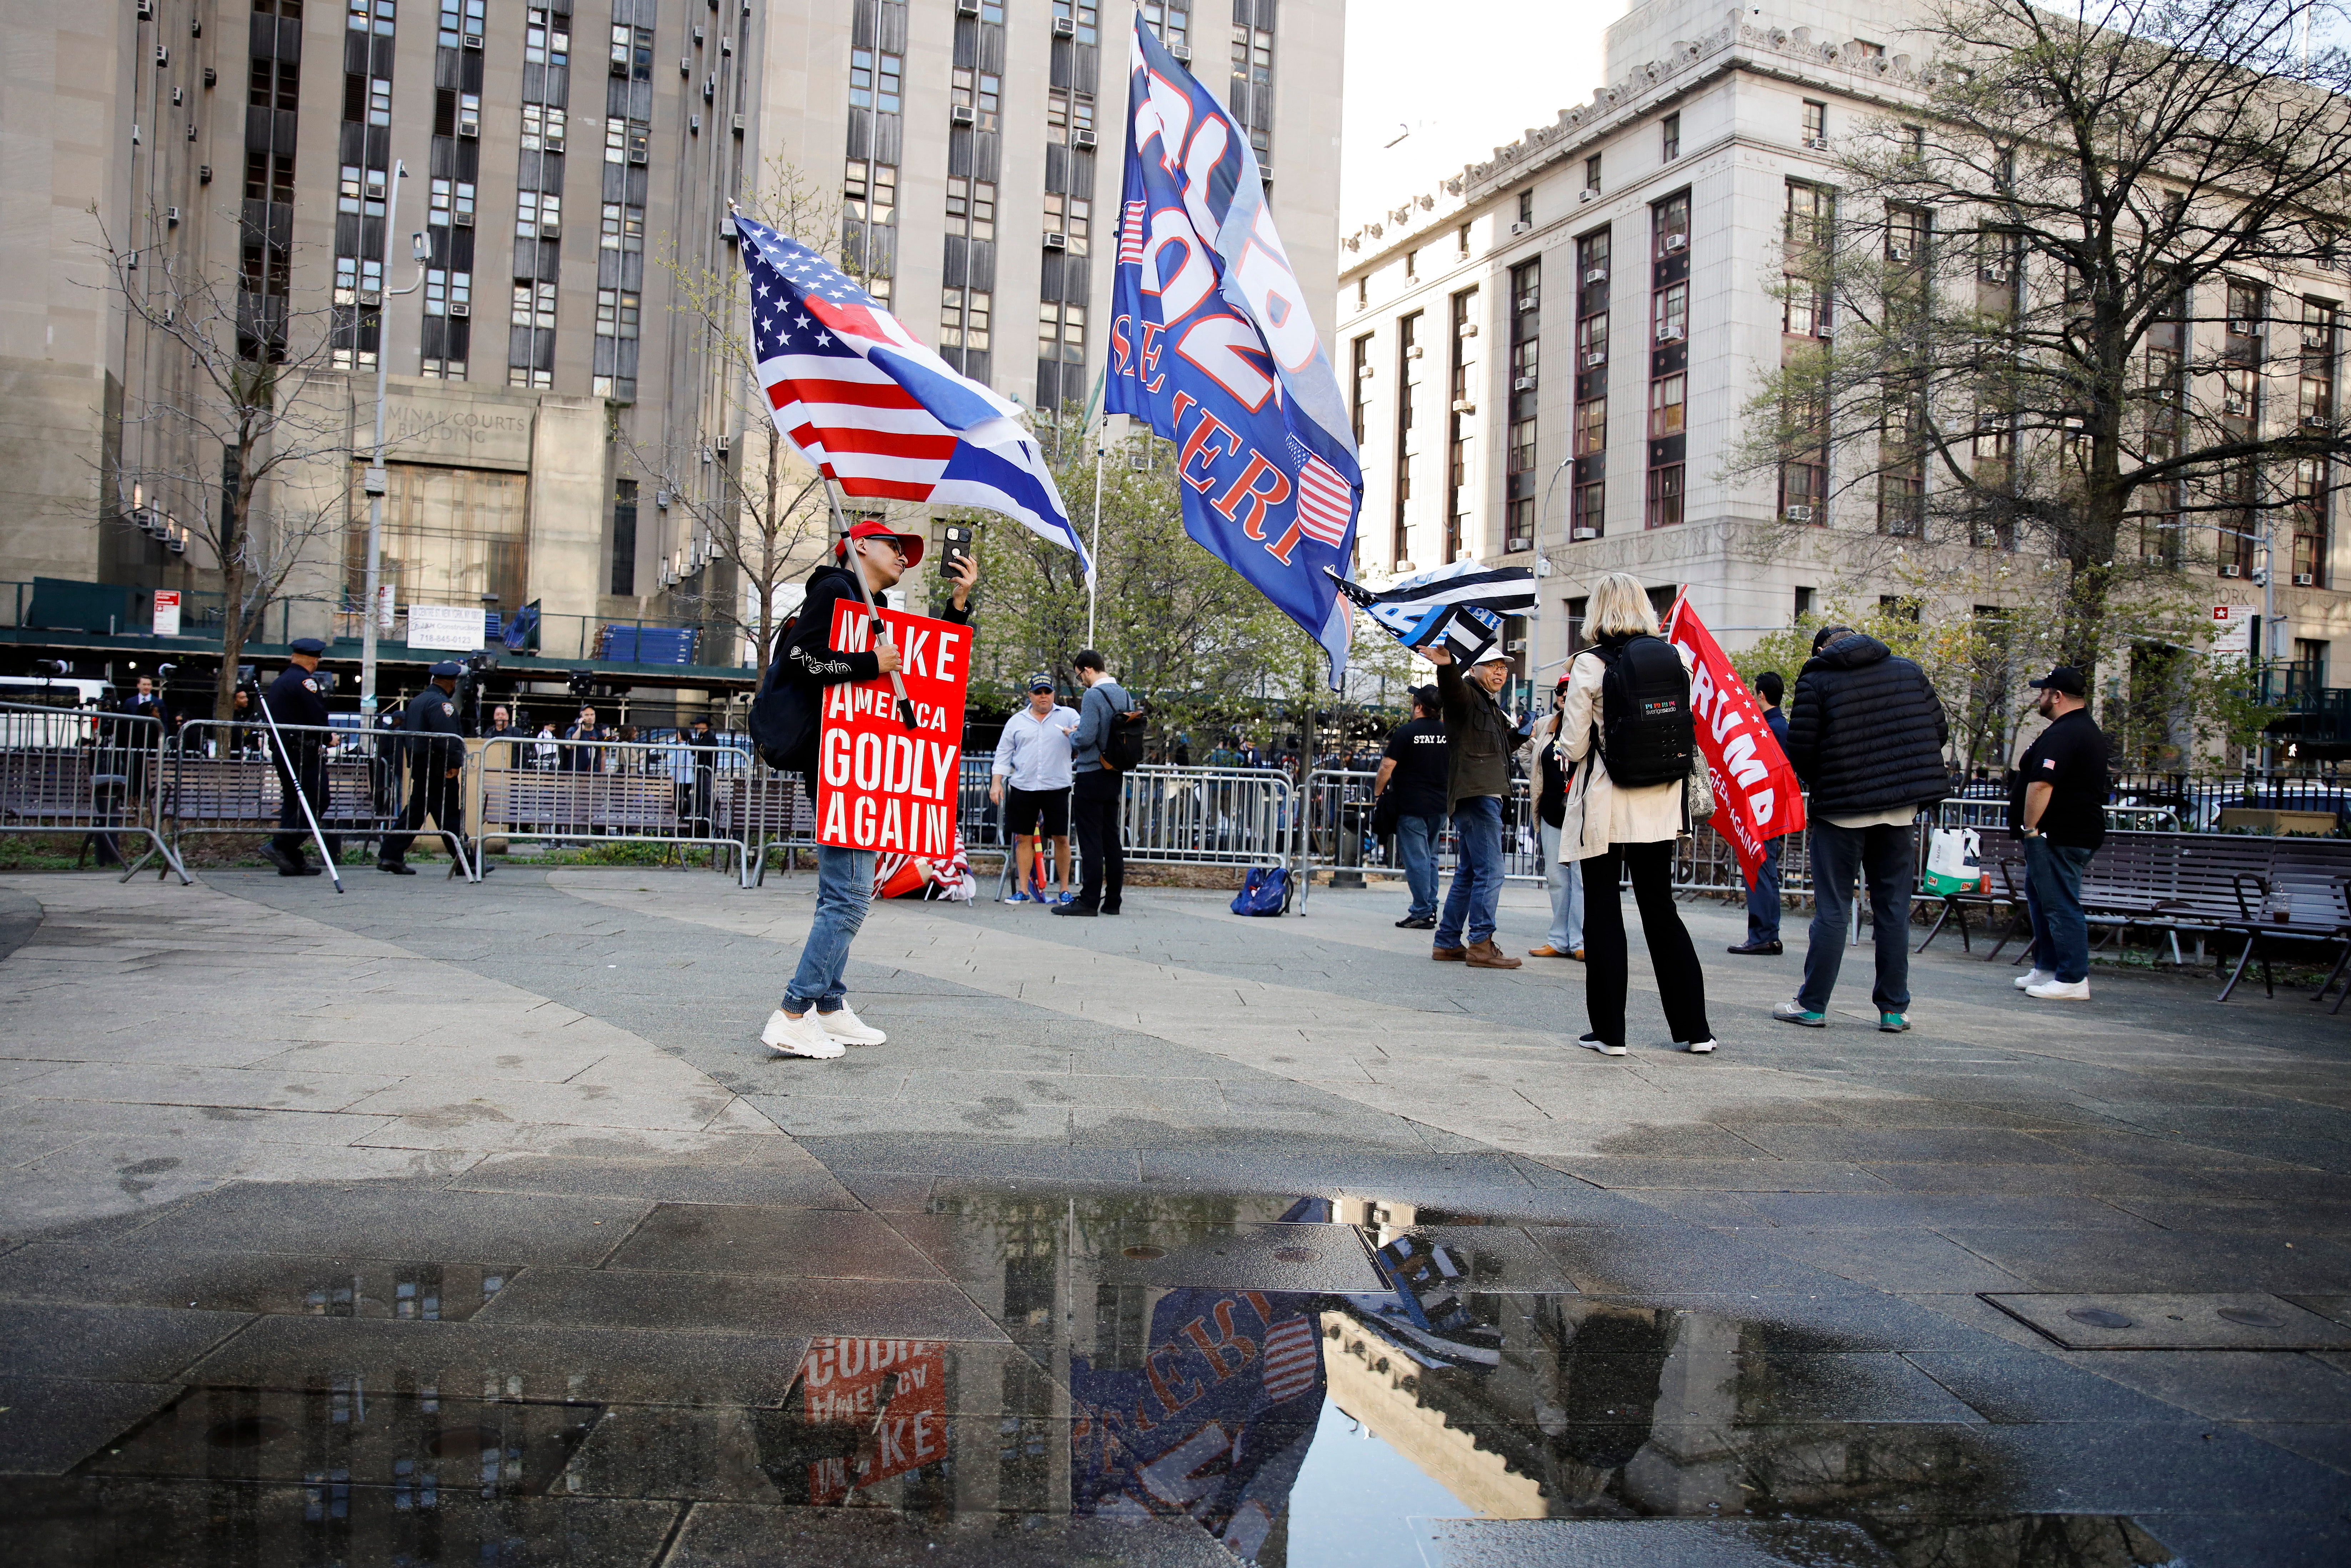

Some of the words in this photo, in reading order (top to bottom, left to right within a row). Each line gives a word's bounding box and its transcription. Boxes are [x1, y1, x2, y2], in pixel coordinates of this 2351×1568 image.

[453, 413, 525, 431] COURTS
[397, 423, 486, 443] BUILDING
[436, 623, 481, 631] Construction
[420, 634, 471, 644] 718-845-0123
[829, 681, 946, 732] AMERCA
[1414, 735, 1435, 744] STAY
[824, 728, 957, 800] GODLY
[822, 791, 947, 855] AGAIN
